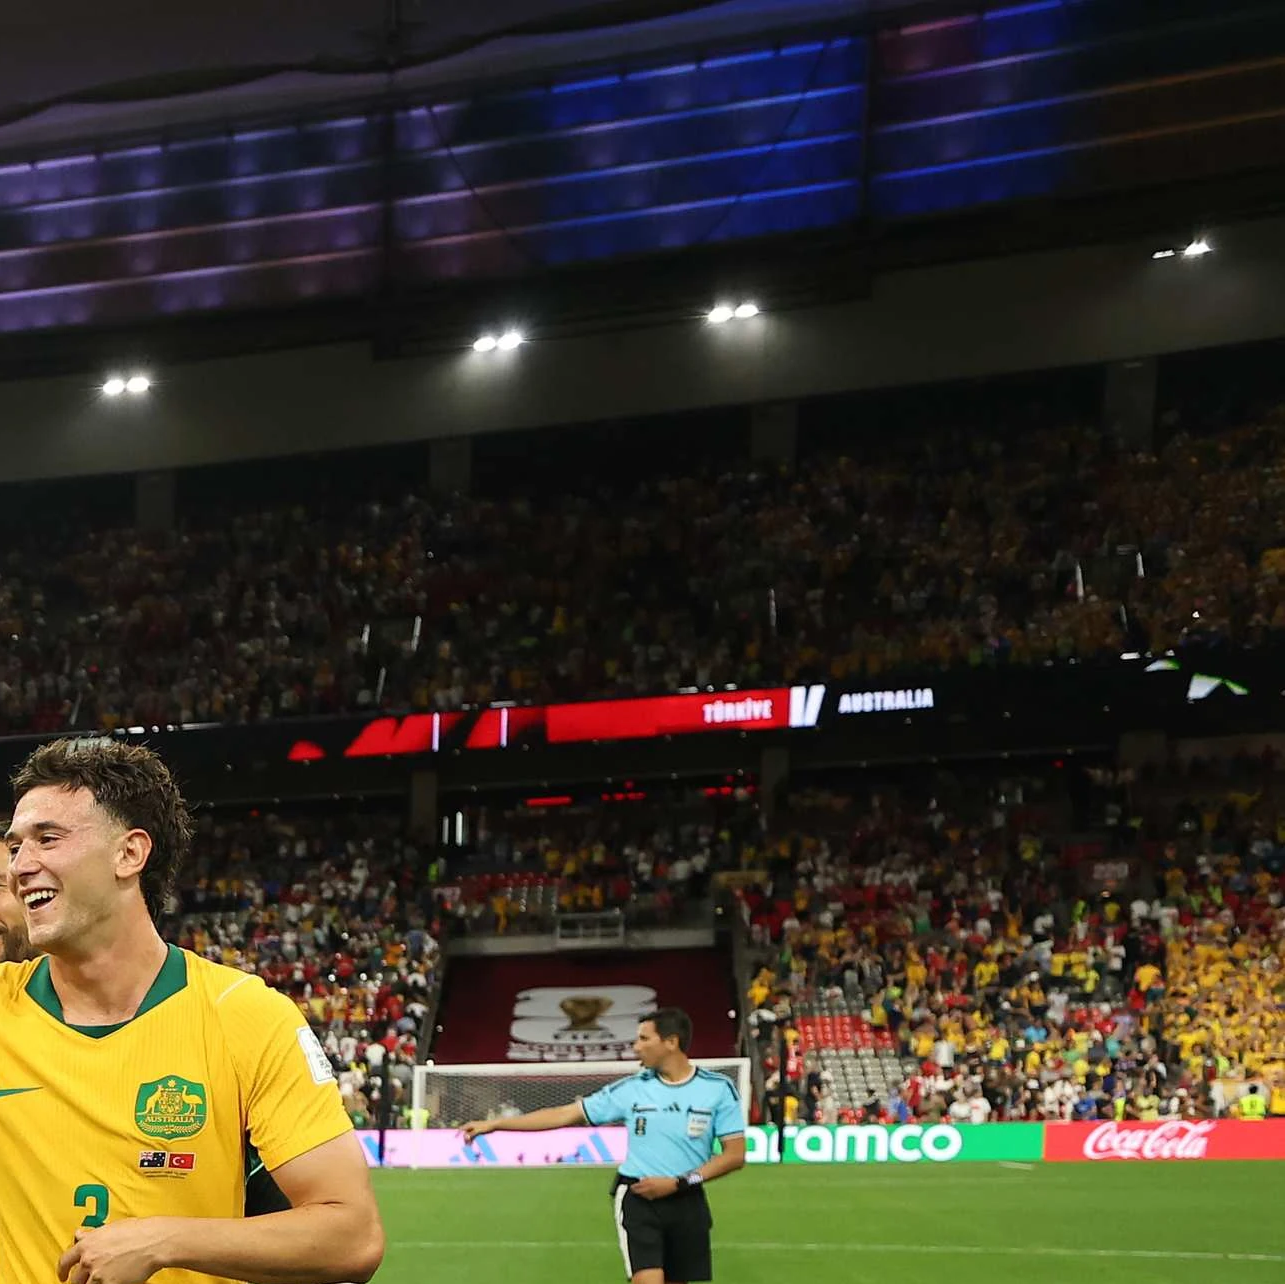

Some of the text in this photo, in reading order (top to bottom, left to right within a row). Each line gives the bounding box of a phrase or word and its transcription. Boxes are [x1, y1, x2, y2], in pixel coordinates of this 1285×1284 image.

[702, 697, 773, 723] TÜRKİYE
[838, 688, 934, 714] AUSTRALIA
[144, 1115, 195, 1123] AUSTRALIA
